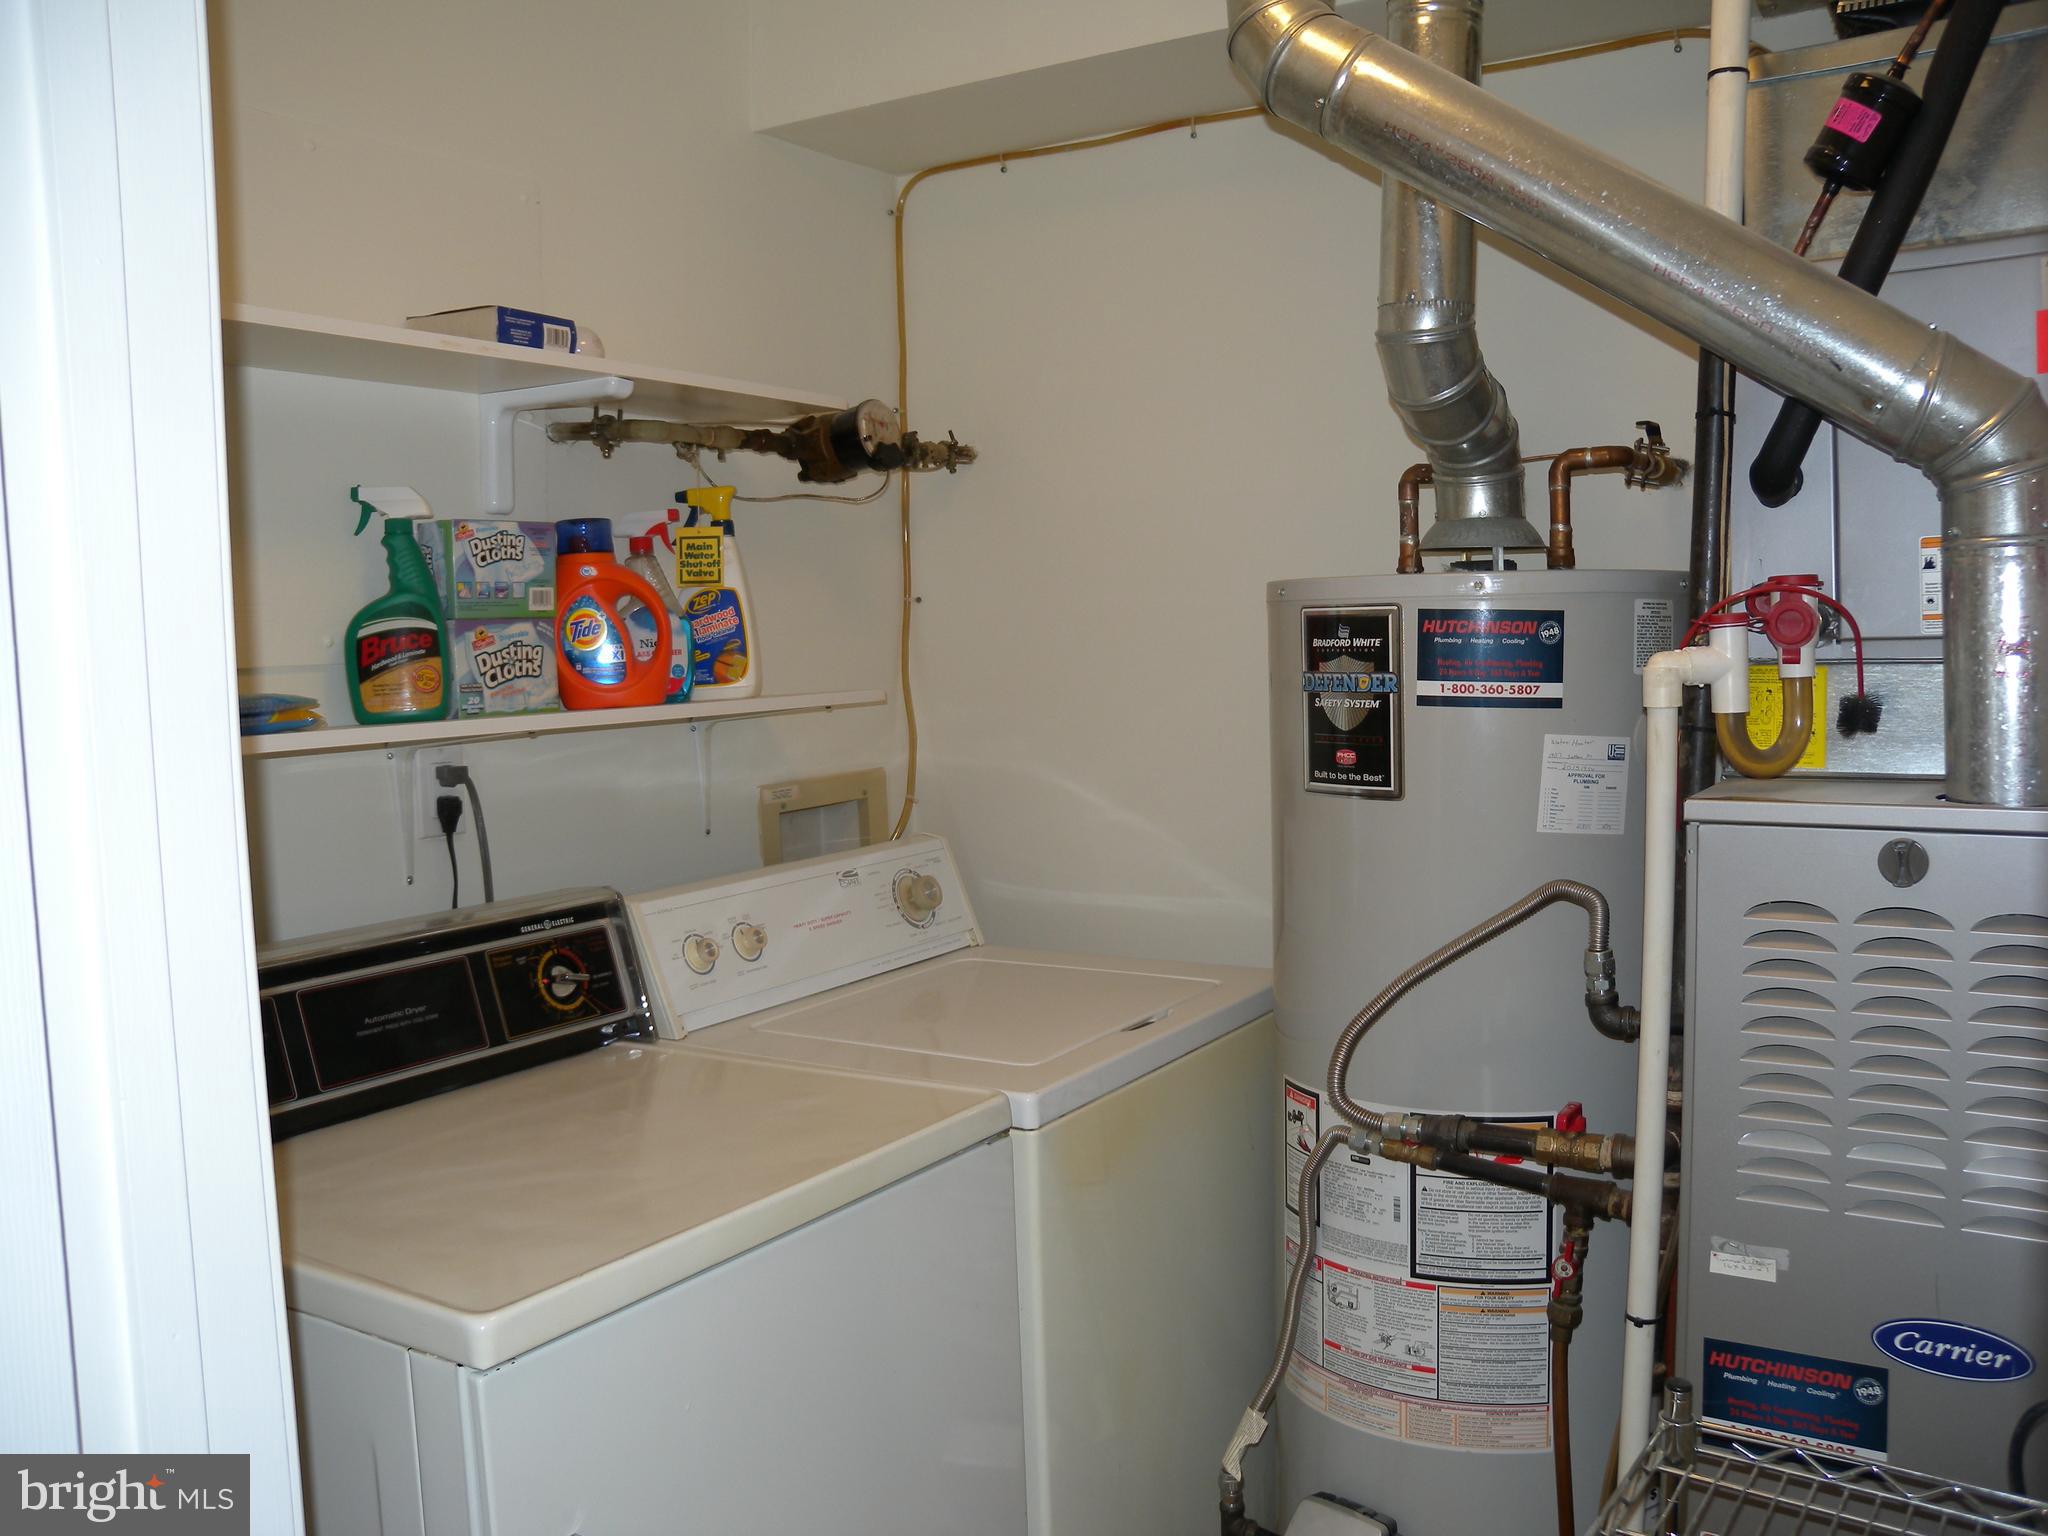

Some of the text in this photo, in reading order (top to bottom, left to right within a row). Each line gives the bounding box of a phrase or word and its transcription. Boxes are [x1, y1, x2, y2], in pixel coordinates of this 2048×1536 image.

[469, 530, 525, 557] Dusting
[686, 542, 713, 550] Main
[684, 552, 715, 560] Water
[680, 560, 720, 568] Shut-off
[686, 569, 714, 577] Valve
[693, 607, 736, 628] ardwood
[570, 619, 601, 643] Tide
[1423, 619, 1538, 634] HUTCHINSON
[1540, 627, 1560, 639] 1948
[1313, 637, 1381, 647] BRADFORD WHITE
[1502, 637, 1525, 645] Cooling
[360, 632, 433, 669] Bruce
[475, 640, 544, 675] Dusting
[1303, 672, 1399, 693] DEFENDER
[1440, 683, 1541, 695] 1-800-360-5807
[1314, 697, 1380, 708] SAFETY SYSTEM
[1314, 770, 1328, 778] Built
[1337, 772, 1347, 780] be
[1348, 773, 1361, 781] the
[1363, 774, 1382, 782] Best
[521, 916, 574, 933] GENERAL ELECTRIC
[1893, 1331, 2012, 1368] Carrier
[1709, 1350, 1853, 1389] HUTCHINSON
[1723, 1372, 1836, 1399] Plumbing Heating Cooling
[1855, 1385, 1881, 1397] 1948
